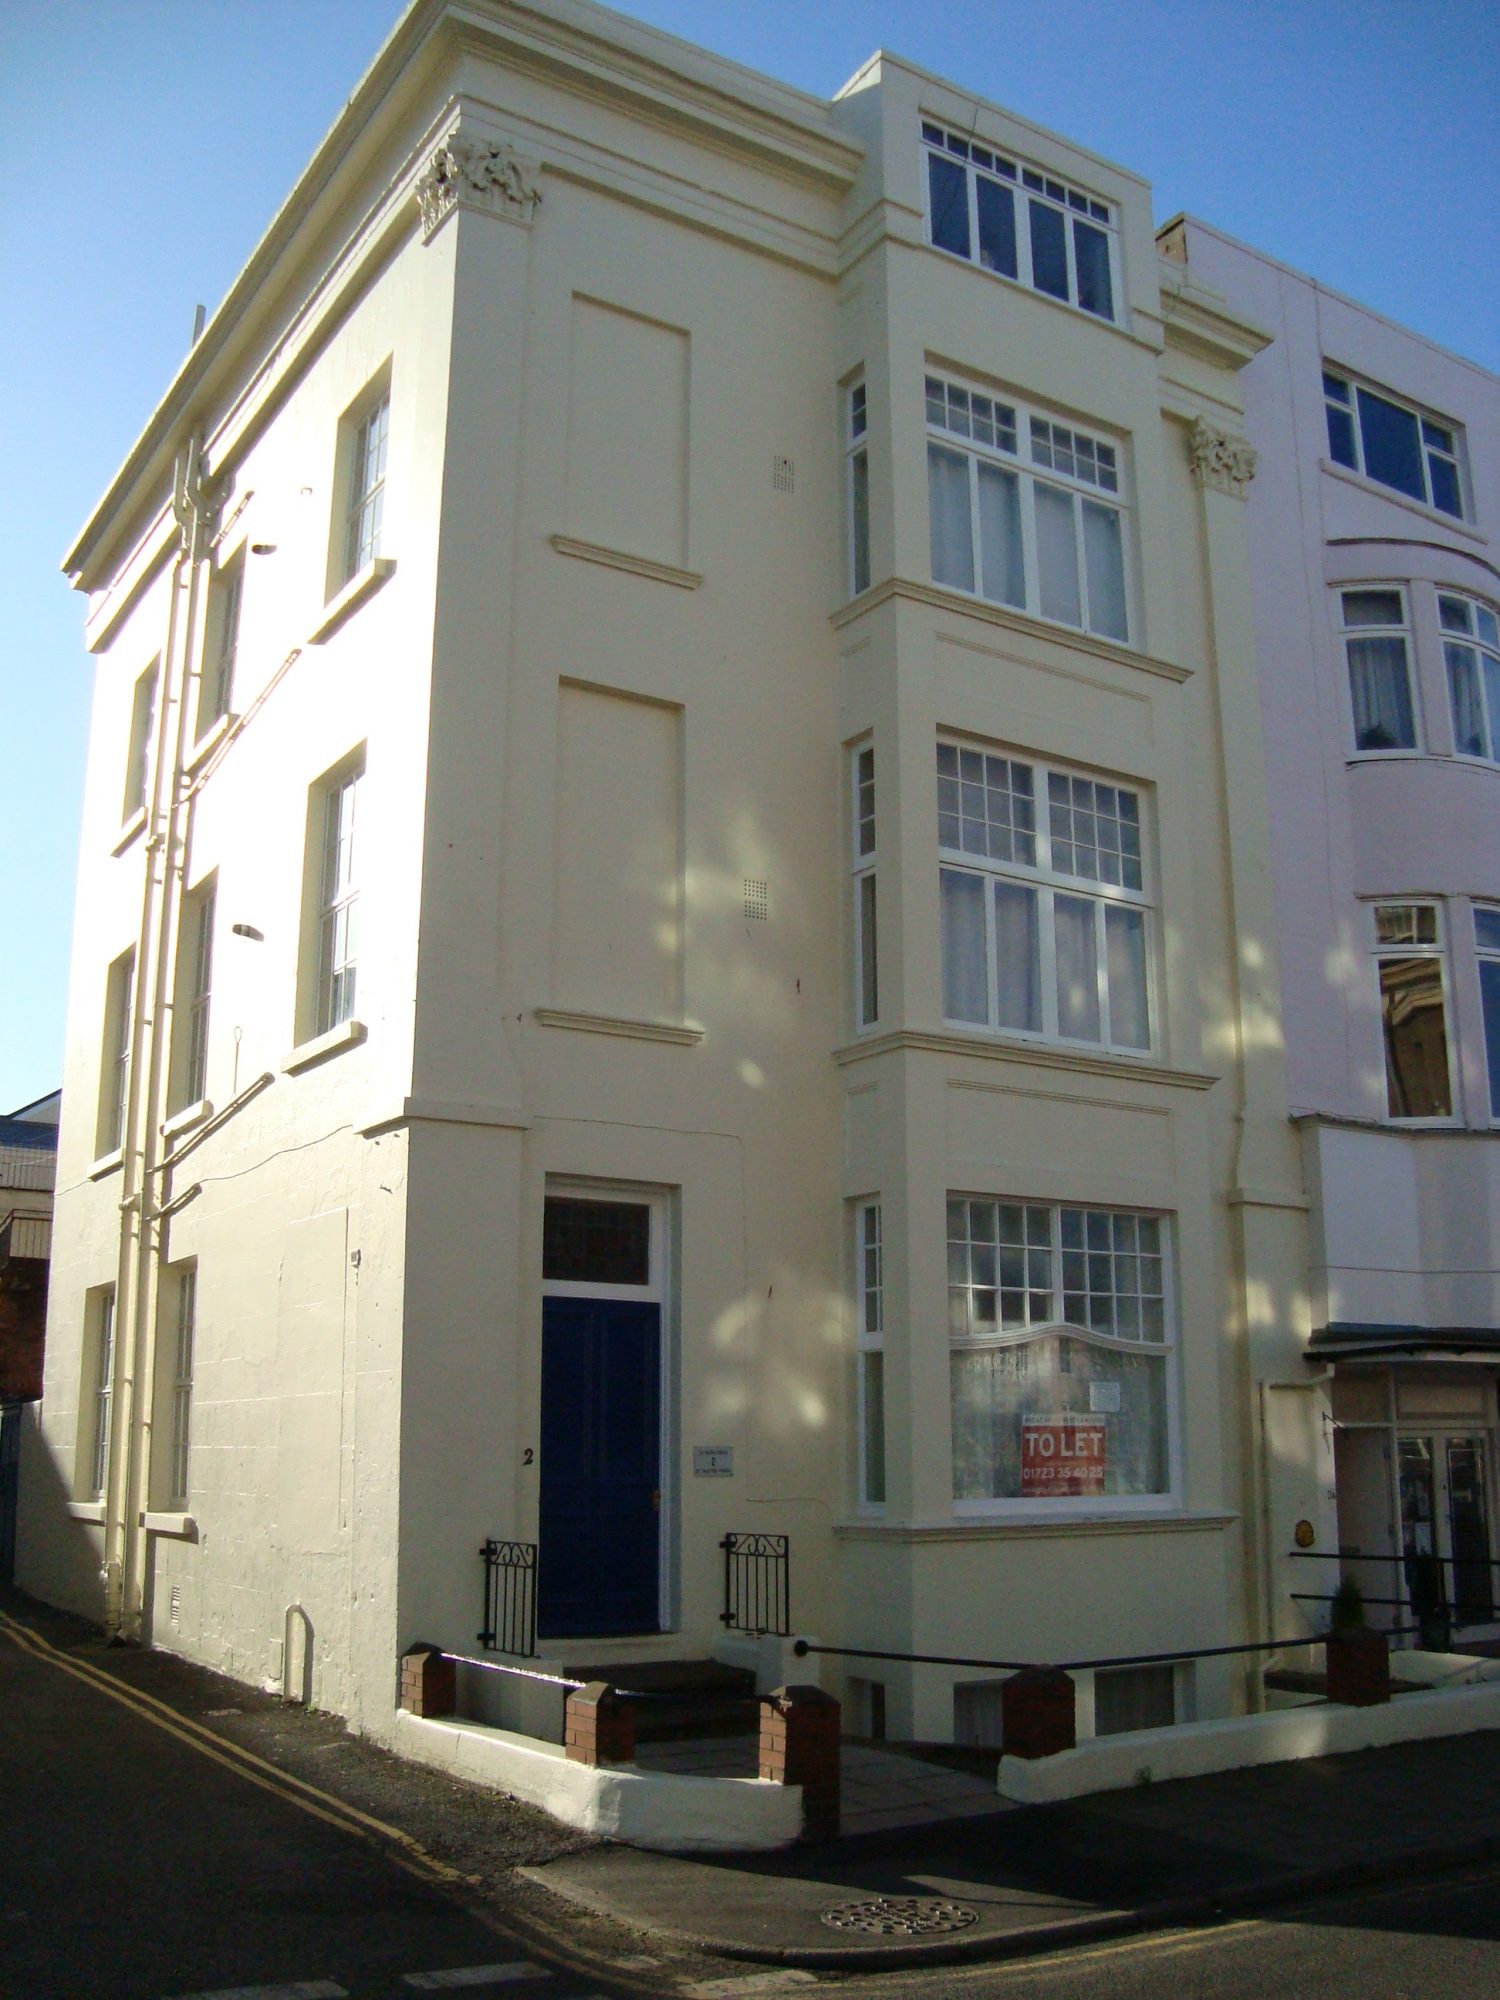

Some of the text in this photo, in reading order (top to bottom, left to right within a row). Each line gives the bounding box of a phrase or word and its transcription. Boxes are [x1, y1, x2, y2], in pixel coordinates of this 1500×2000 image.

[1025, 1433, 1102, 1456] TO LET
[523, 1448, 533, 1465] 2
[1024, 1468, 1055, 1479] 01723
[1058, 1467, 1071, 1478] 35
